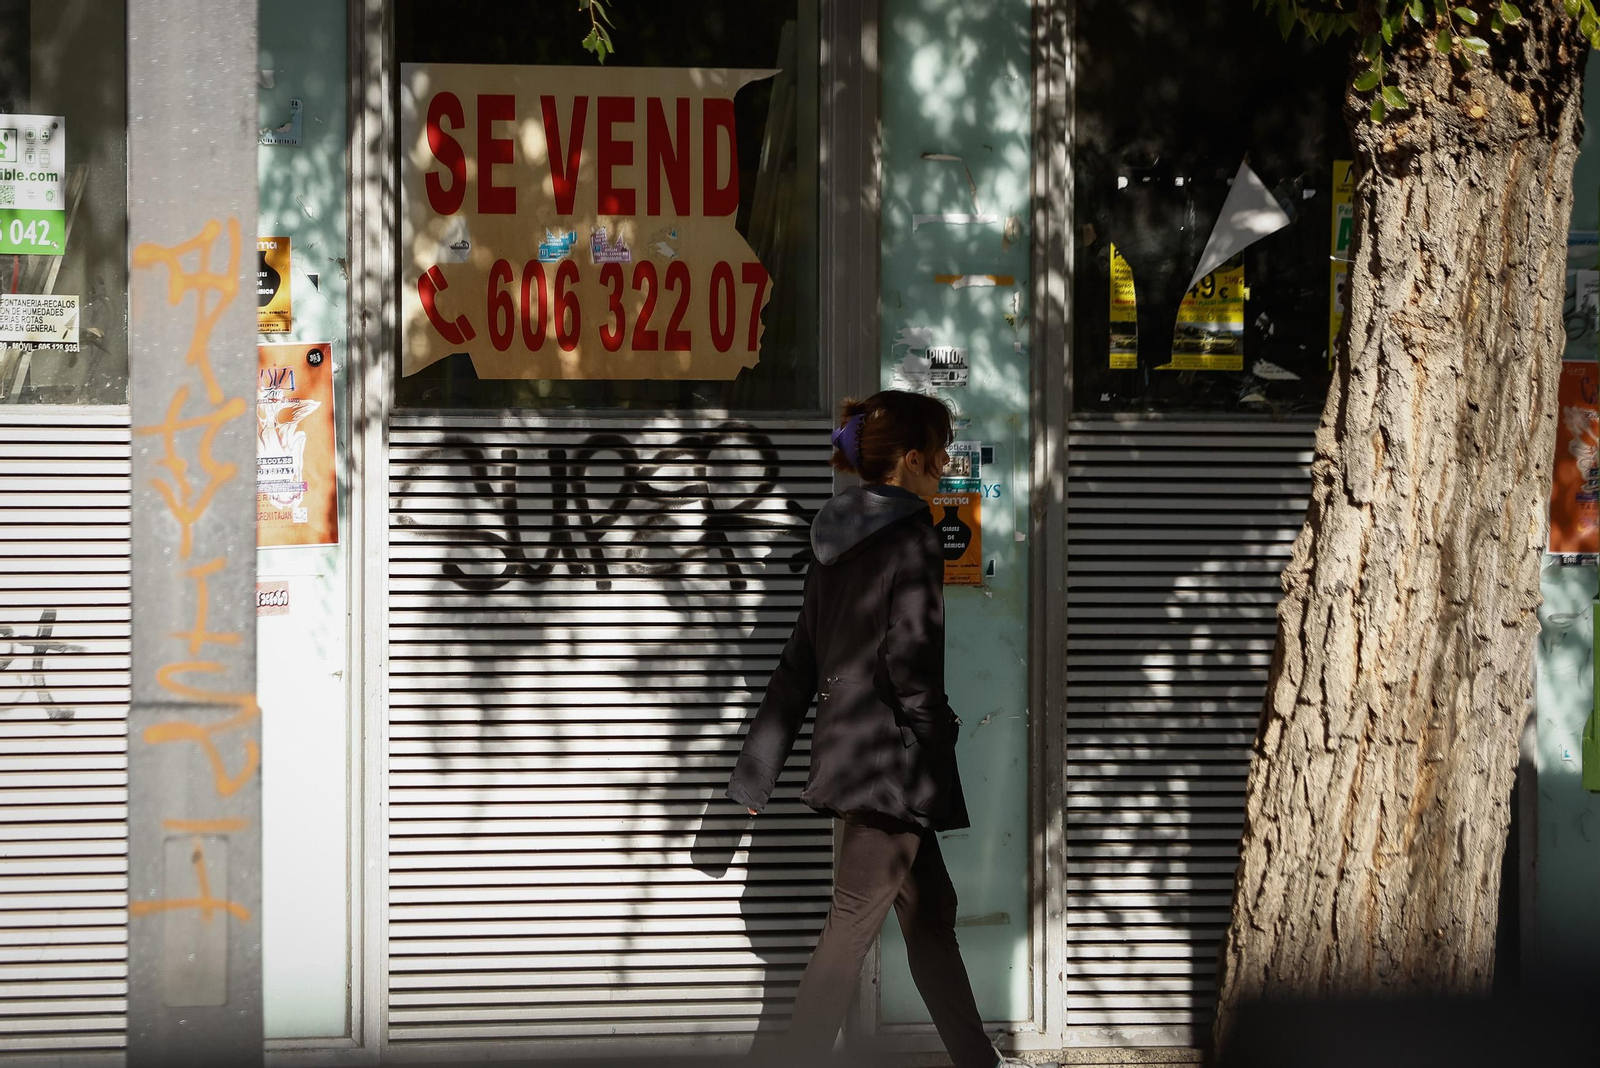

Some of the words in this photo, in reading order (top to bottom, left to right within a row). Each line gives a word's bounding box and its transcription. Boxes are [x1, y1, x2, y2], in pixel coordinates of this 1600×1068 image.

[425, 91, 516, 215] SE
[540, 95, 739, 217] VEND
[10, 219, 51, 245] 042
[487, 258, 581, 353] 606
[599, 260, 692, 353] 322
[709, 260, 769, 353] 07
[23, 308, 64, 317] HUMEDADES
[21, 316, 44, 324] ROTAS
[15, 324, 24, 332] EN
[946, 444, 973, 453] pticas
[932, 497, 969, 506] croma
